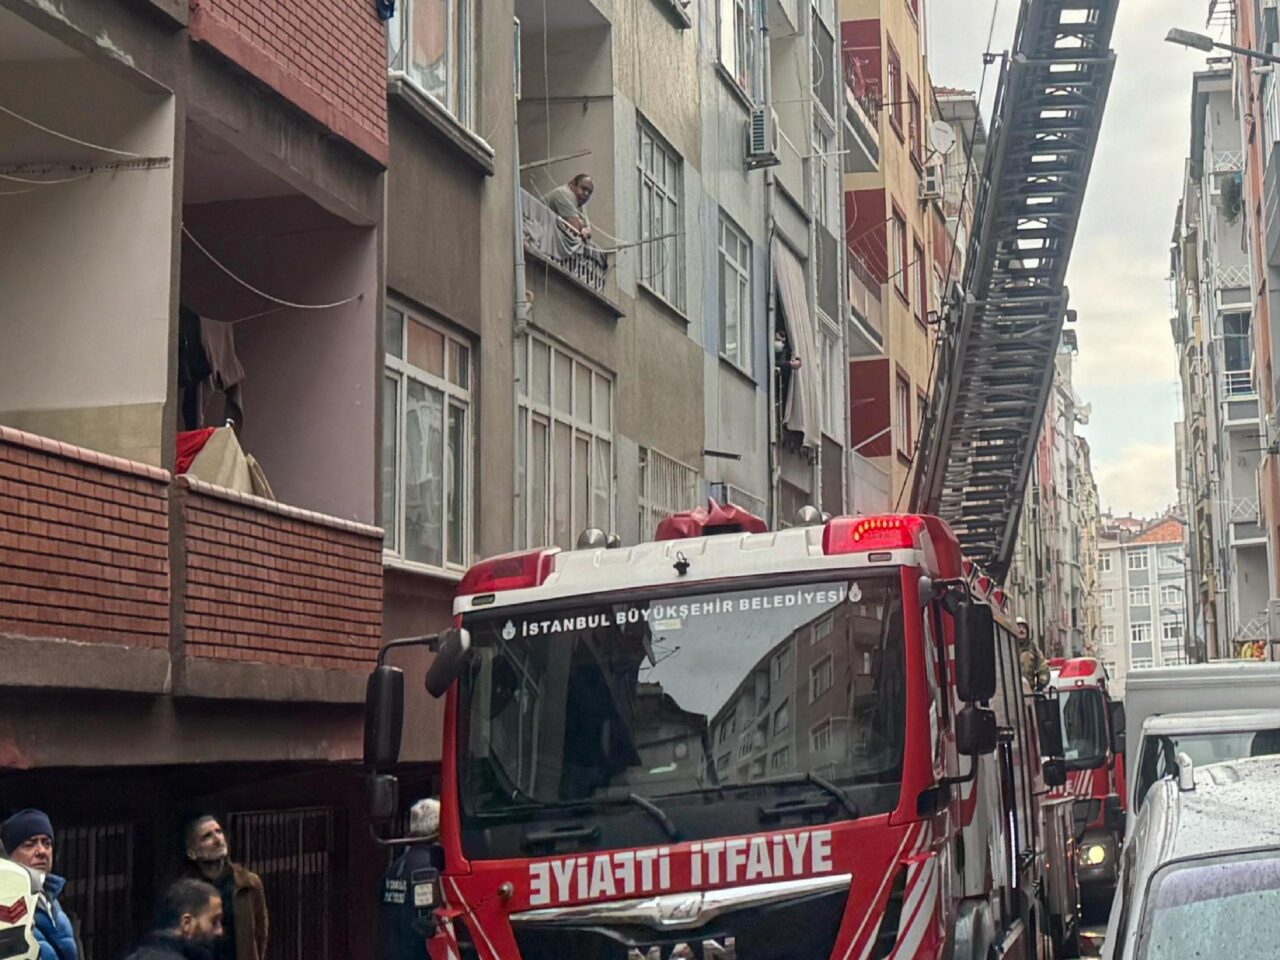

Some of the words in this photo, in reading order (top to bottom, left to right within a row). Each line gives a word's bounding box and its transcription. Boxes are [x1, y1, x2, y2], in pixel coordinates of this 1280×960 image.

[522, 614, 610, 637] İSTANBUL
[616, 598, 733, 625] BÜYÜKŞEHİR
[739, 586, 844, 611] BELEDİYESİ
